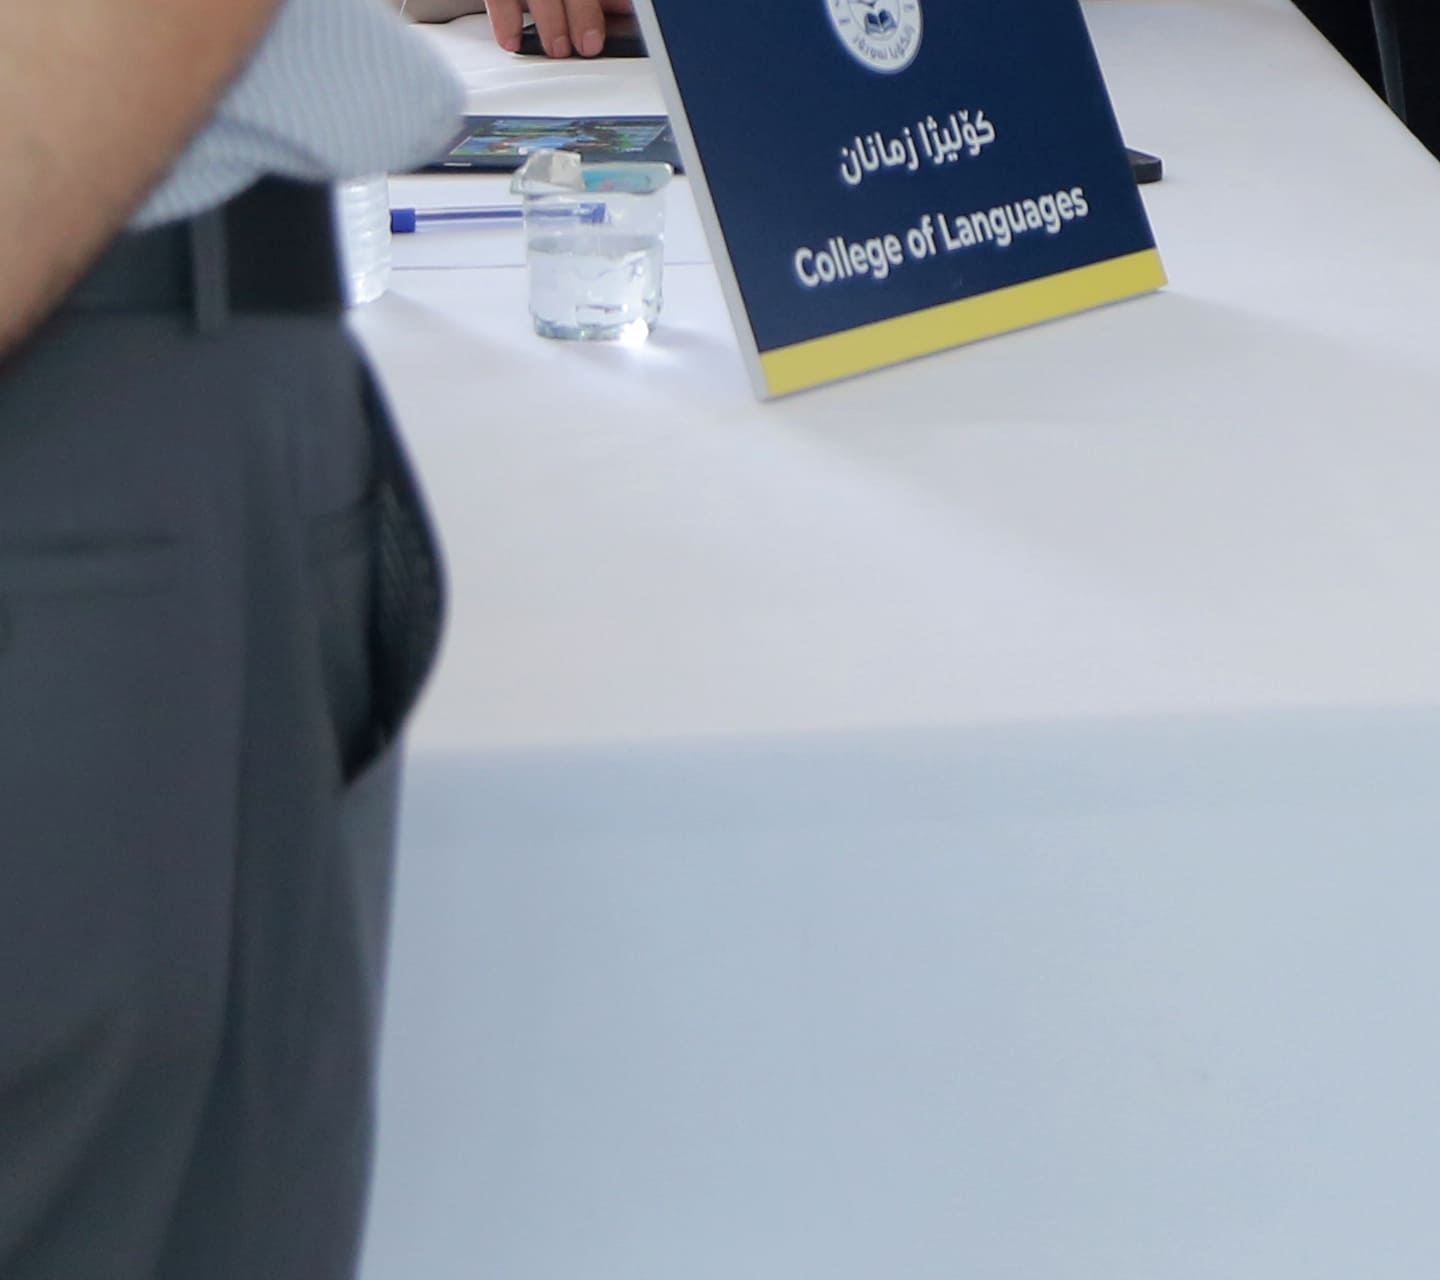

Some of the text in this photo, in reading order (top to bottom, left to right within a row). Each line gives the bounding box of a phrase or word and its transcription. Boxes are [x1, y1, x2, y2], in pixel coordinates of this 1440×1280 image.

[841, 127, 920, 185] زمانان
[794, 186, 1089, 287] College of Languages
